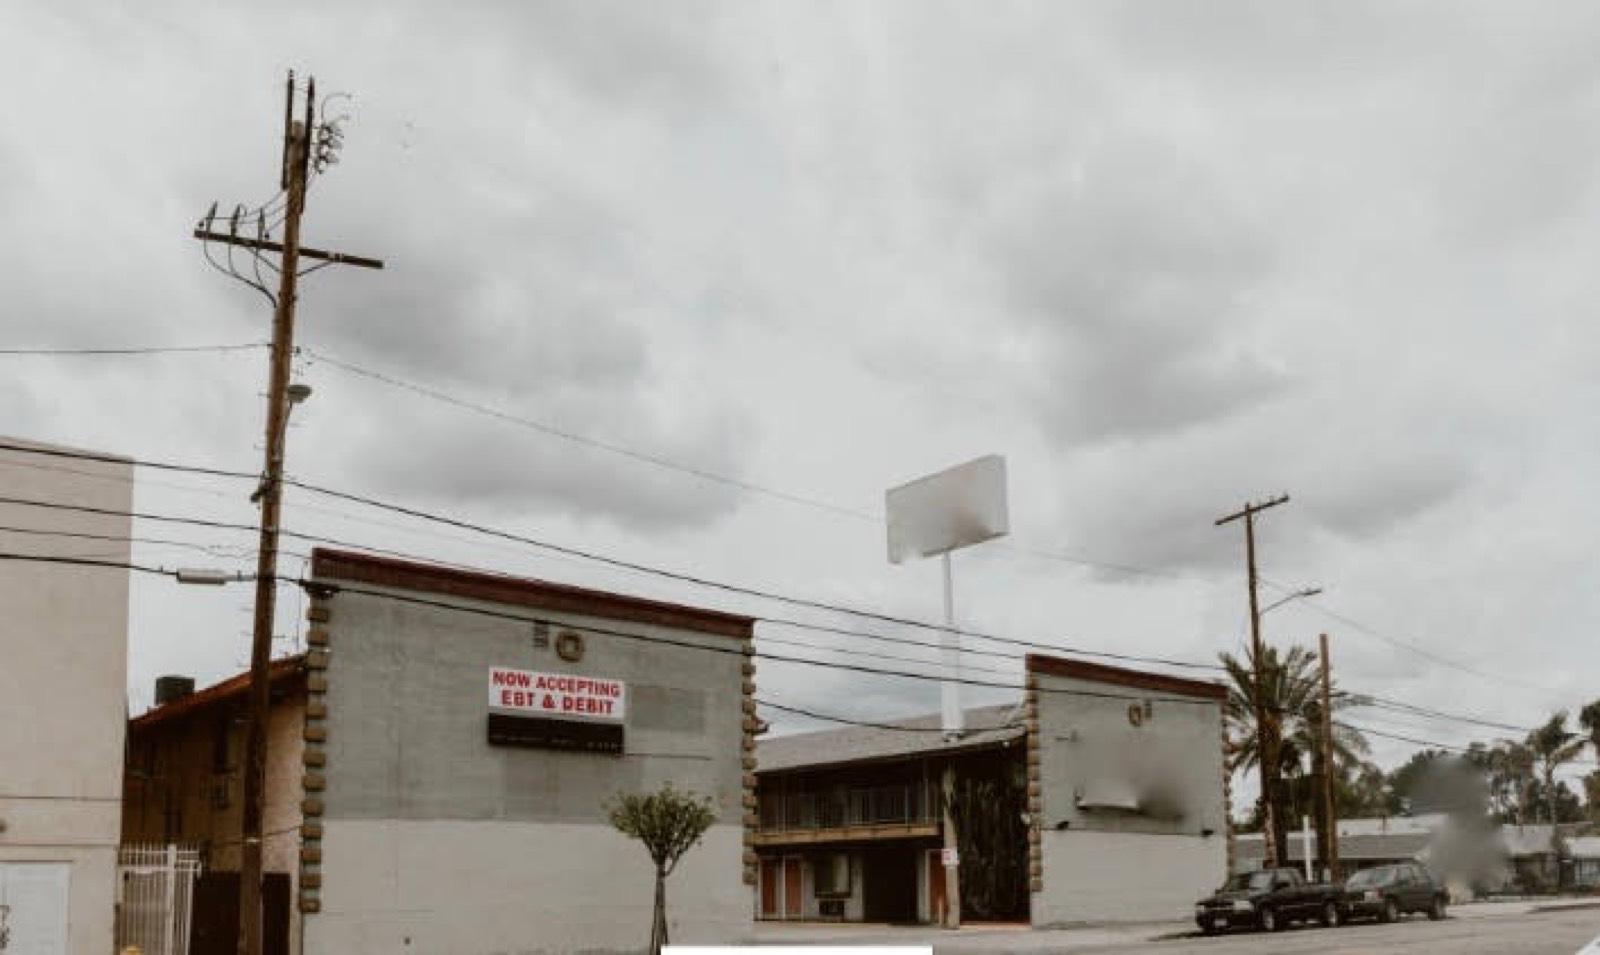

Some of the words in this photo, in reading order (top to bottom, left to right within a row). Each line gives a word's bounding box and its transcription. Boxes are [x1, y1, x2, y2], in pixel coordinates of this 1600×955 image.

[493, 671, 531, 688] NOW
[536, 676, 620, 698] ACCEPTING
[502, 689, 536, 706] EBT
[542, 694, 556, 709] &
[563, 696, 614, 713] DEBIT
